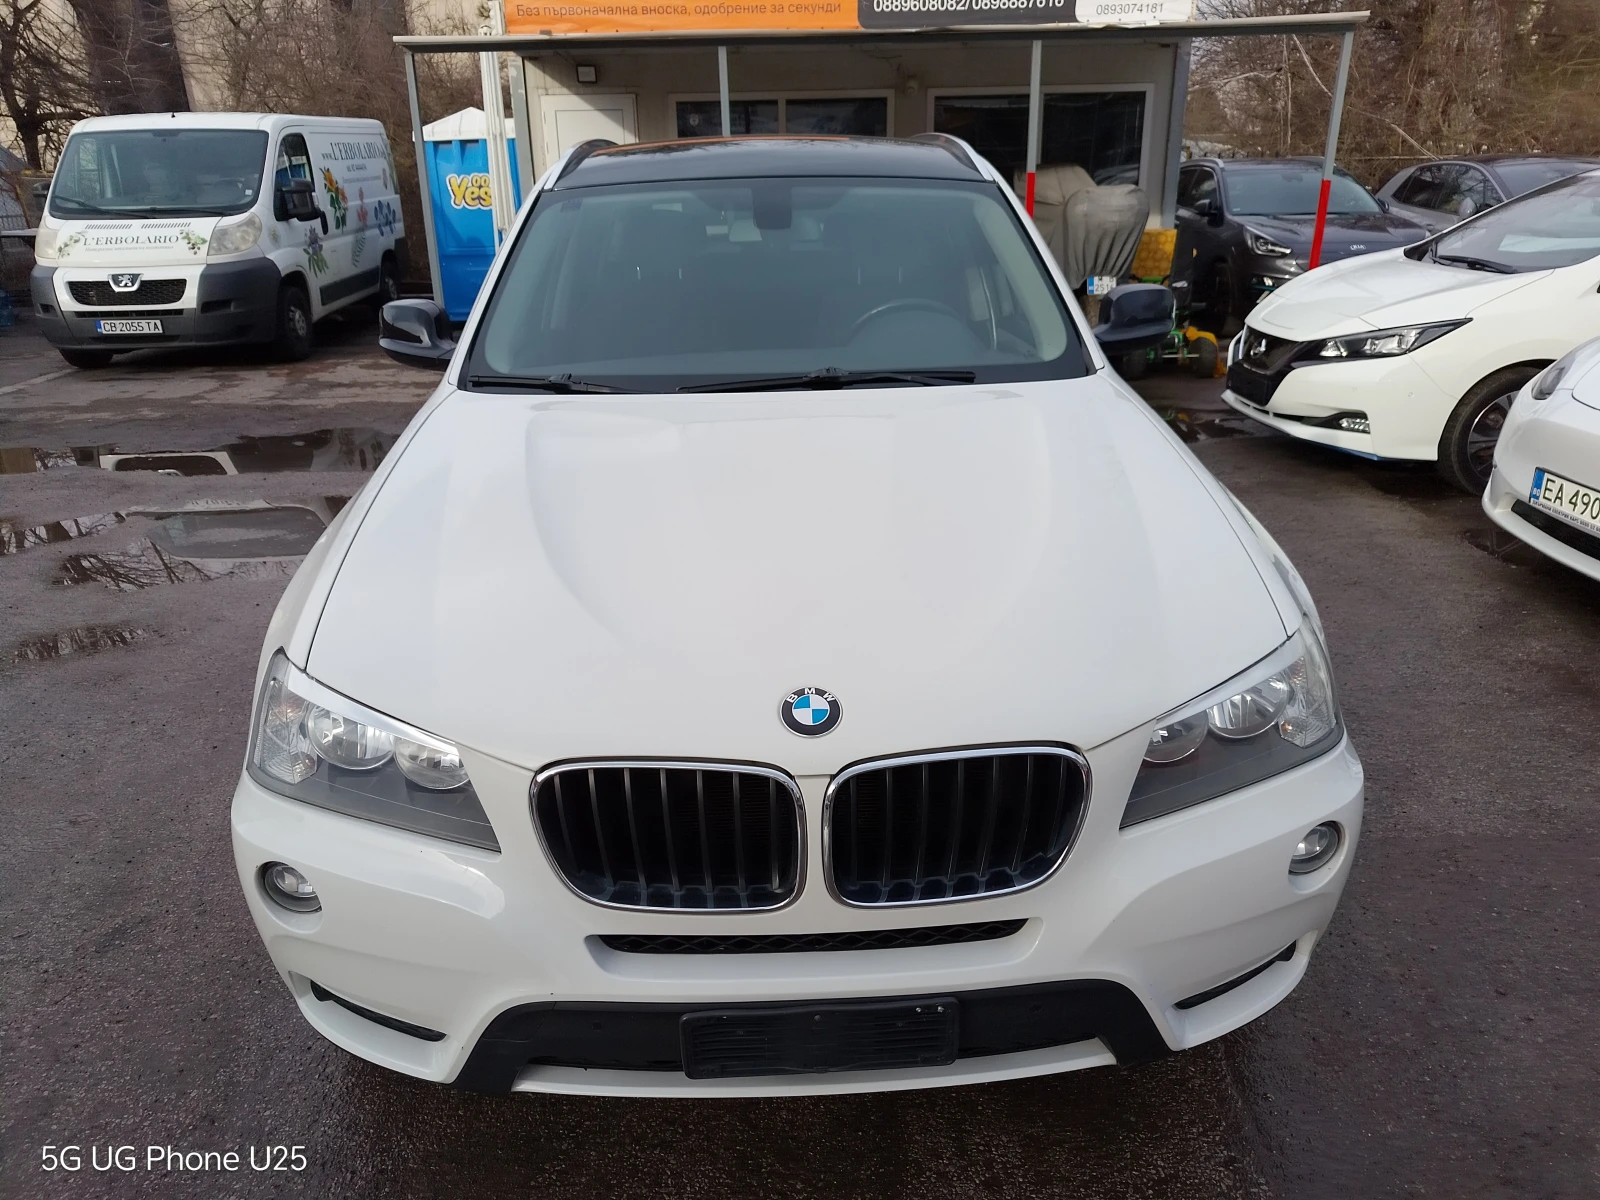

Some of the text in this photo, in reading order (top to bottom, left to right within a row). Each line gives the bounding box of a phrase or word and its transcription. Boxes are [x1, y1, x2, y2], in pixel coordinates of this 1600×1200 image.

[516, 2, 842, 18] Без първоначална вноска, одобрение за секунди
[1096, 3, 1164, 15] 0893074181
[83, 234, 180, 246] L'ERBOLARIO
[103, 322, 117, 332] CB
[118, 322, 144, 332] 2055
[145, 321, 160, 332] TA
[1542, 477, 1565, 507] EA
[786, 687, 837, 703] BMW
